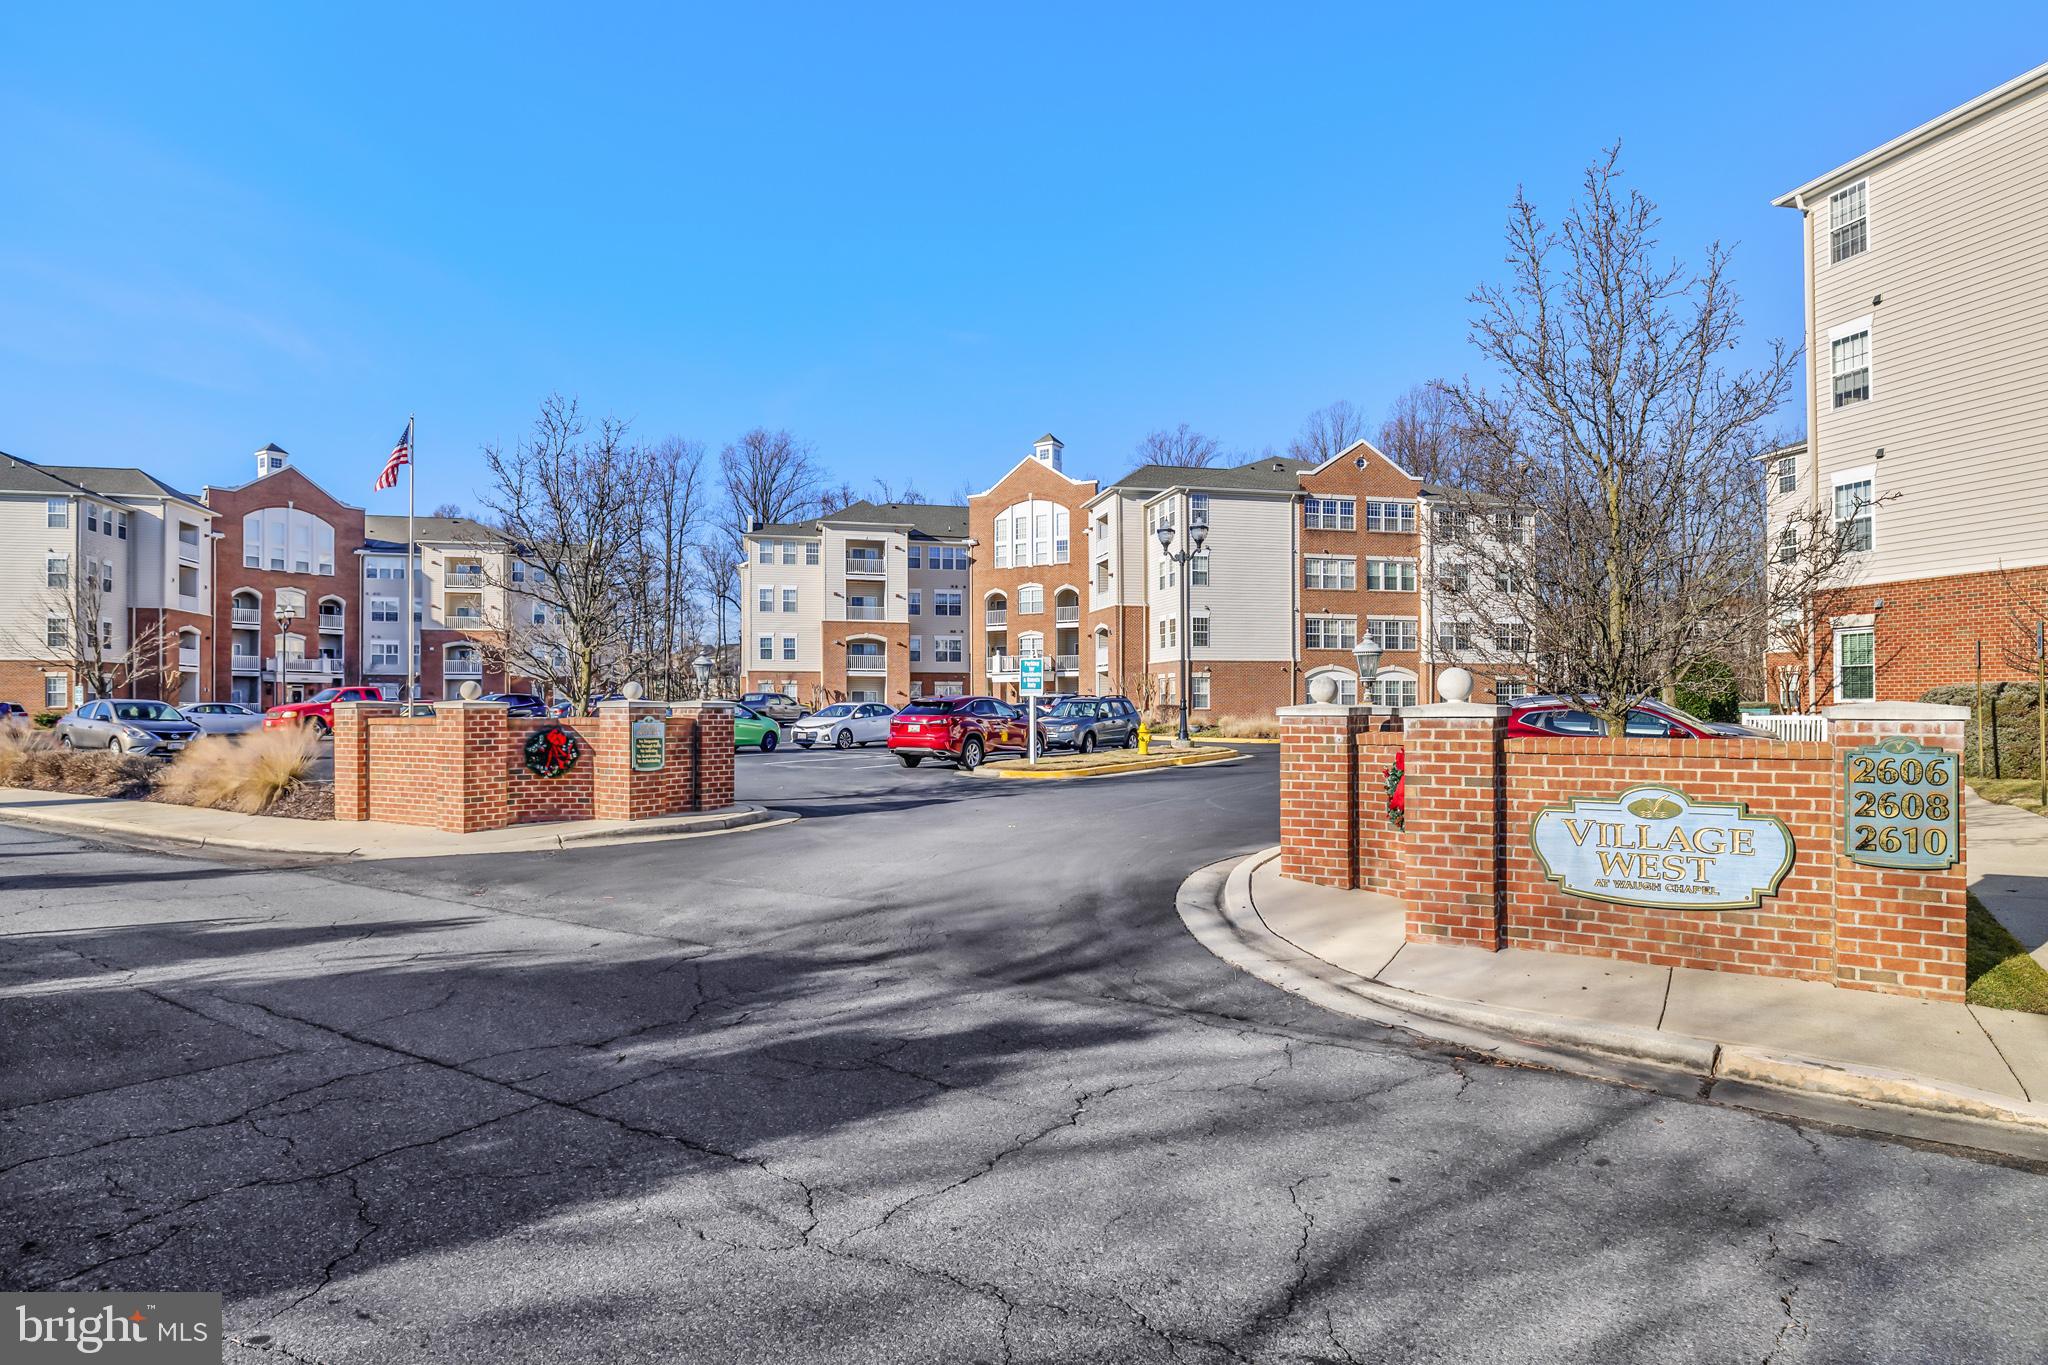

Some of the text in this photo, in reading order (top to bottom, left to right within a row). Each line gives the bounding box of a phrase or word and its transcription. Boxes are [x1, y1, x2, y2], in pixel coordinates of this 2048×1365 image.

[1853, 757, 1949, 786] 2606
[1854, 791, 1950, 821] 2608
[1561, 818, 1756, 856] VILLAGE
[1855, 825, 1948, 856] 2610
[1596, 851, 1716, 883] WEST
[1594, 878, 1721, 896] AT WAUGH CHAPEL
